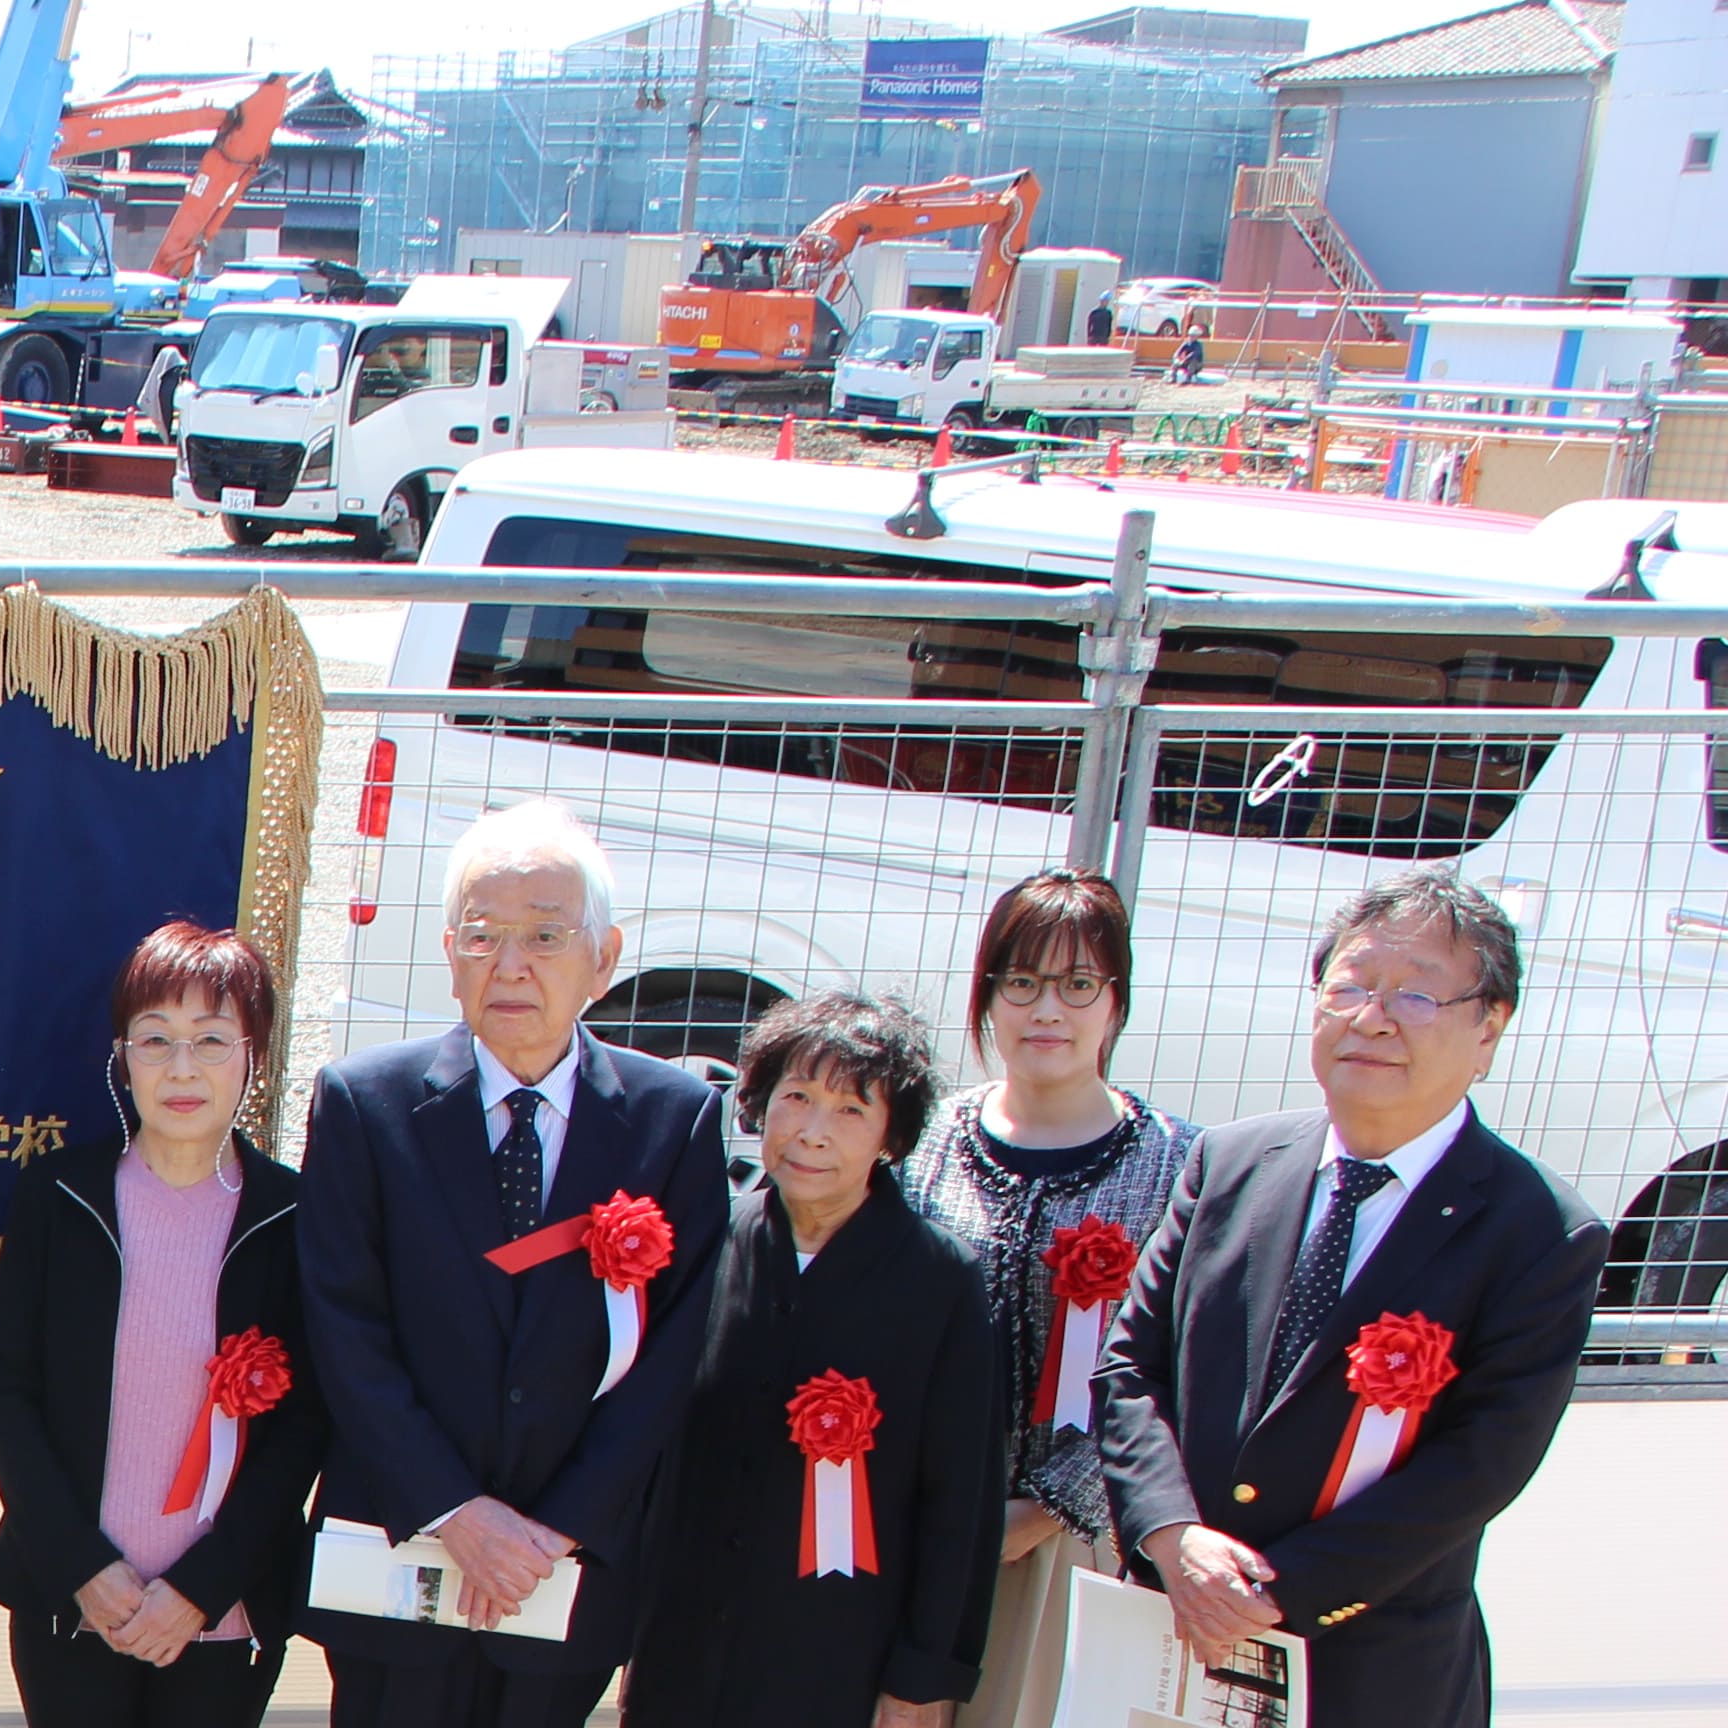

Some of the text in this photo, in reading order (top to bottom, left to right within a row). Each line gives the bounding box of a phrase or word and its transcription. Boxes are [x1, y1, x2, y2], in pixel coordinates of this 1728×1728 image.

[870, 78, 979, 95] Panasonic Homes
[663, 304, 708, 321] HITACHI
